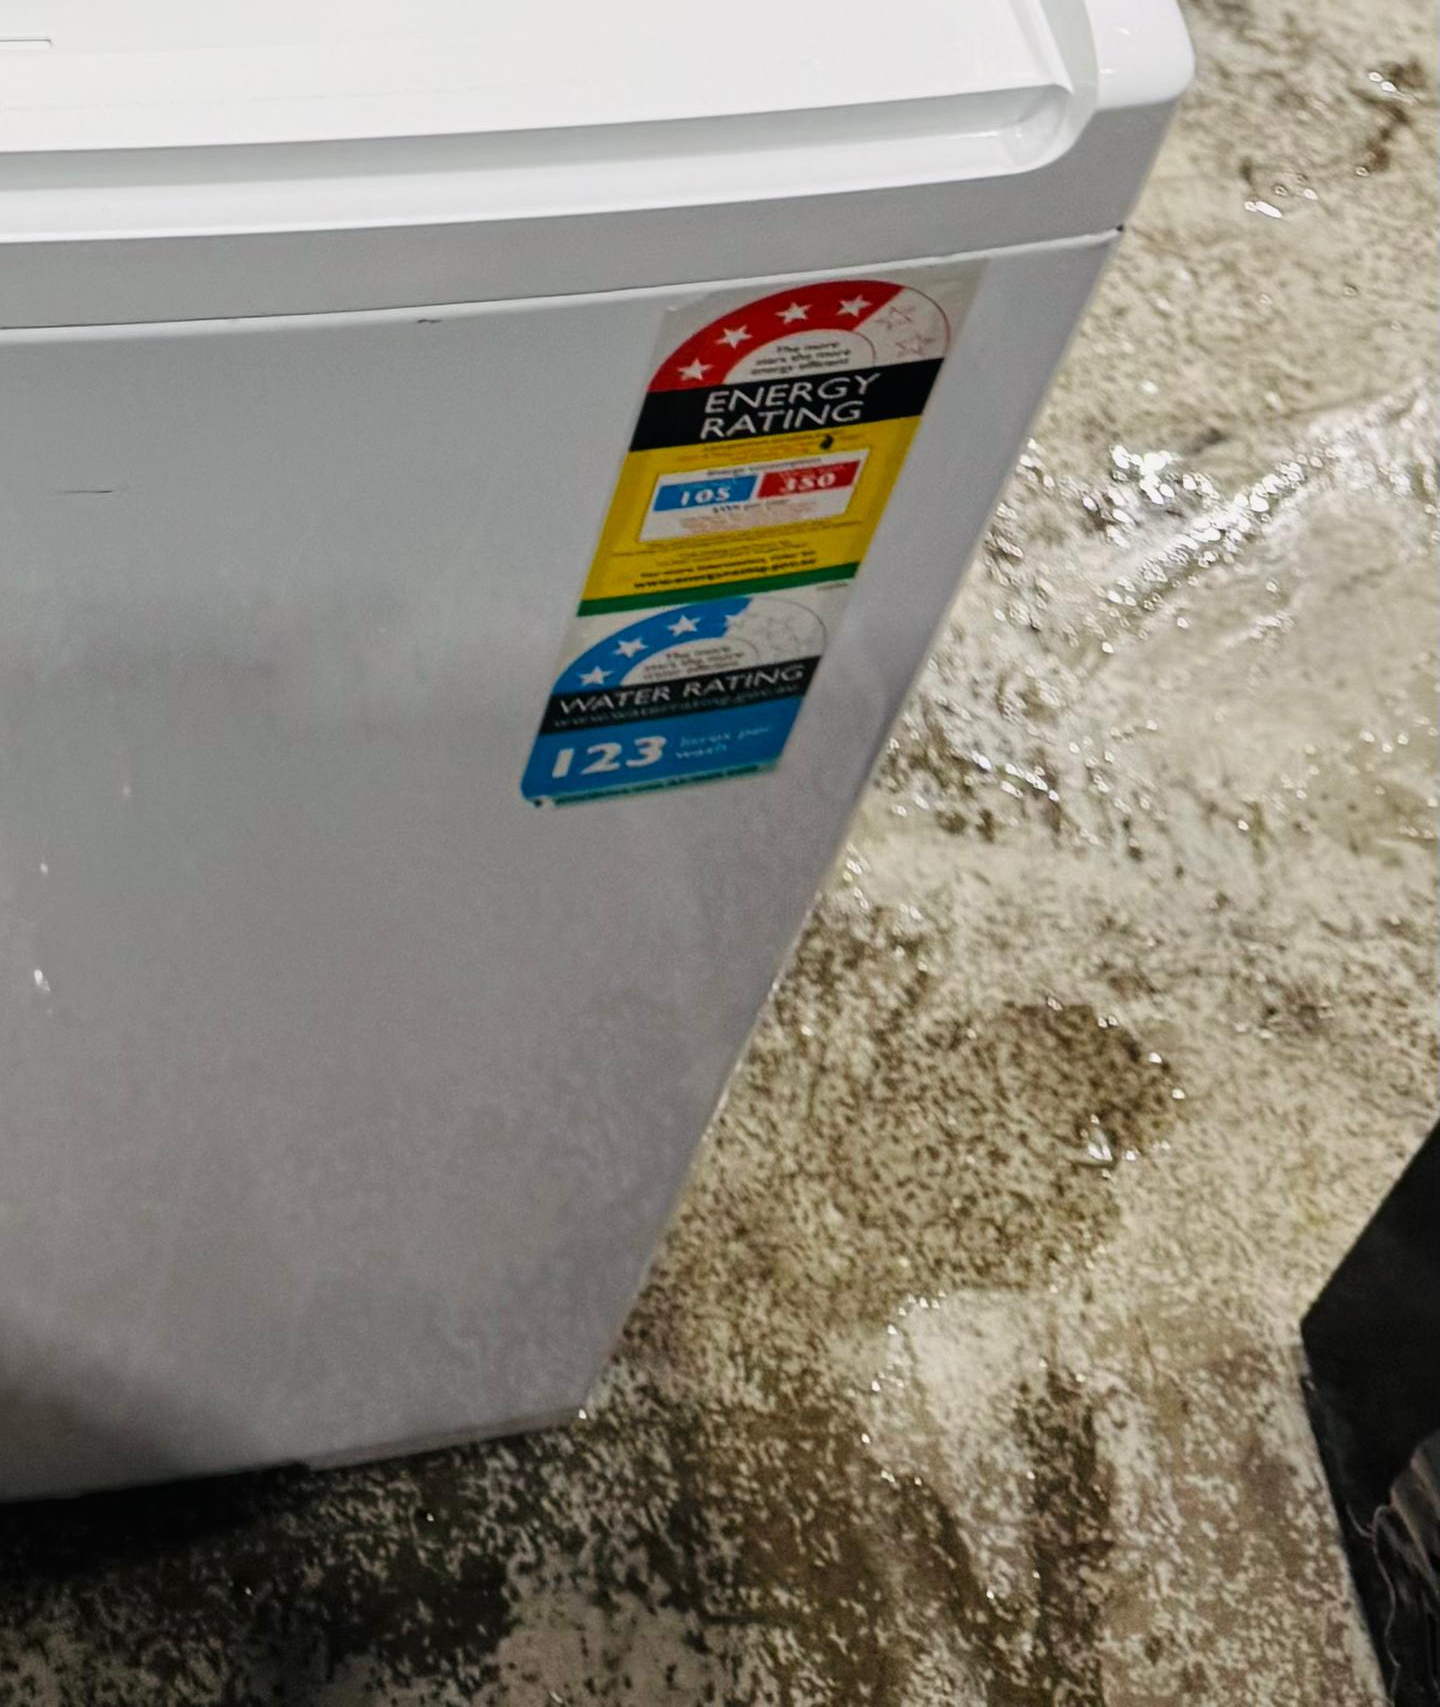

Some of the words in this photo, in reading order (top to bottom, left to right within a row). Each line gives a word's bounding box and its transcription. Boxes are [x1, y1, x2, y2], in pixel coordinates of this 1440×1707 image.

[704, 372, 881, 414] ENERGY
[700, 399, 864, 440] RATING
[679, 486, 732, 507] 105
[560, 685, 672, 715] WATER
[682, 663, 807, 698] RATING
[551, 735, 667, 779] 123
